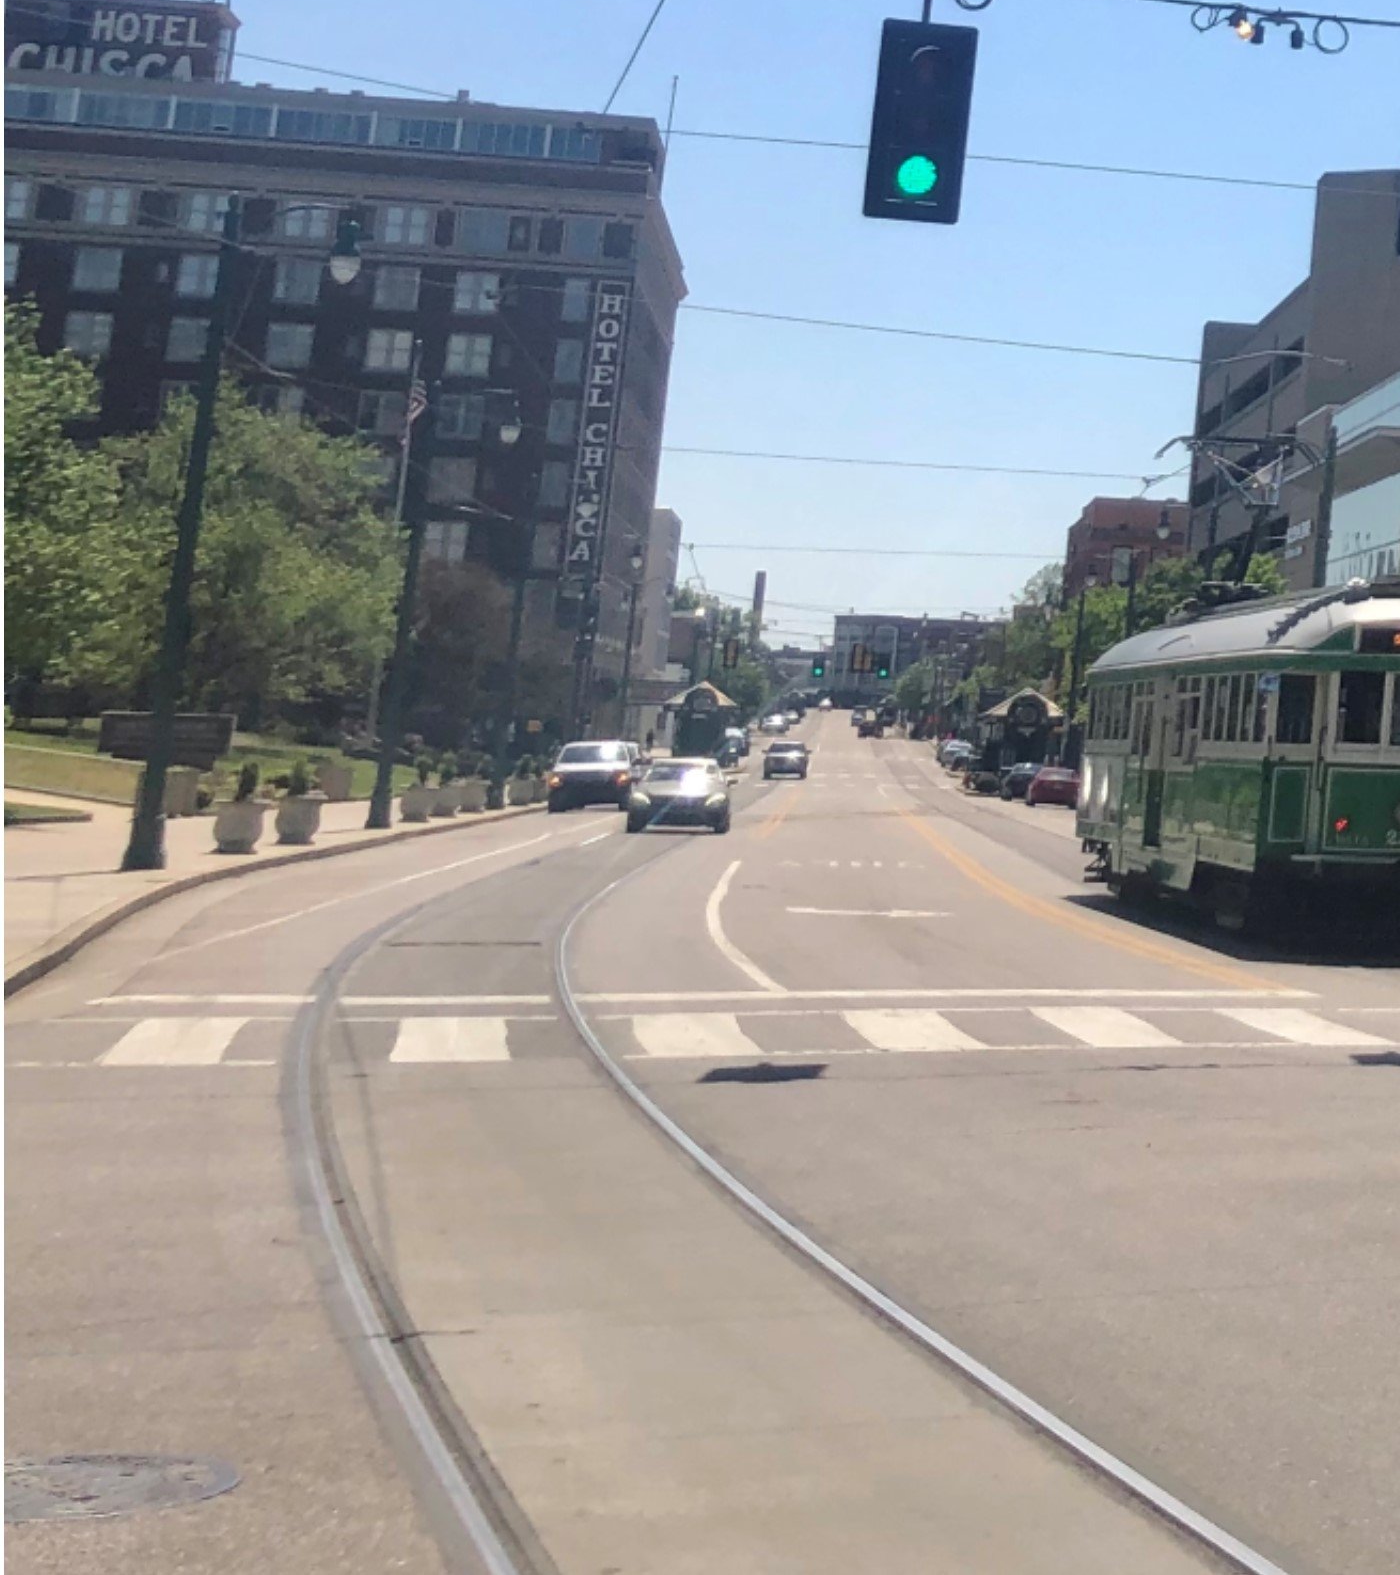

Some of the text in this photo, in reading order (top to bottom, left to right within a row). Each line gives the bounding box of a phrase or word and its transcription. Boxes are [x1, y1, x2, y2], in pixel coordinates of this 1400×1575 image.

[92, 10, 208, 49] HOTEL
[569, 293, 624, 562] HOTEL CHICA
